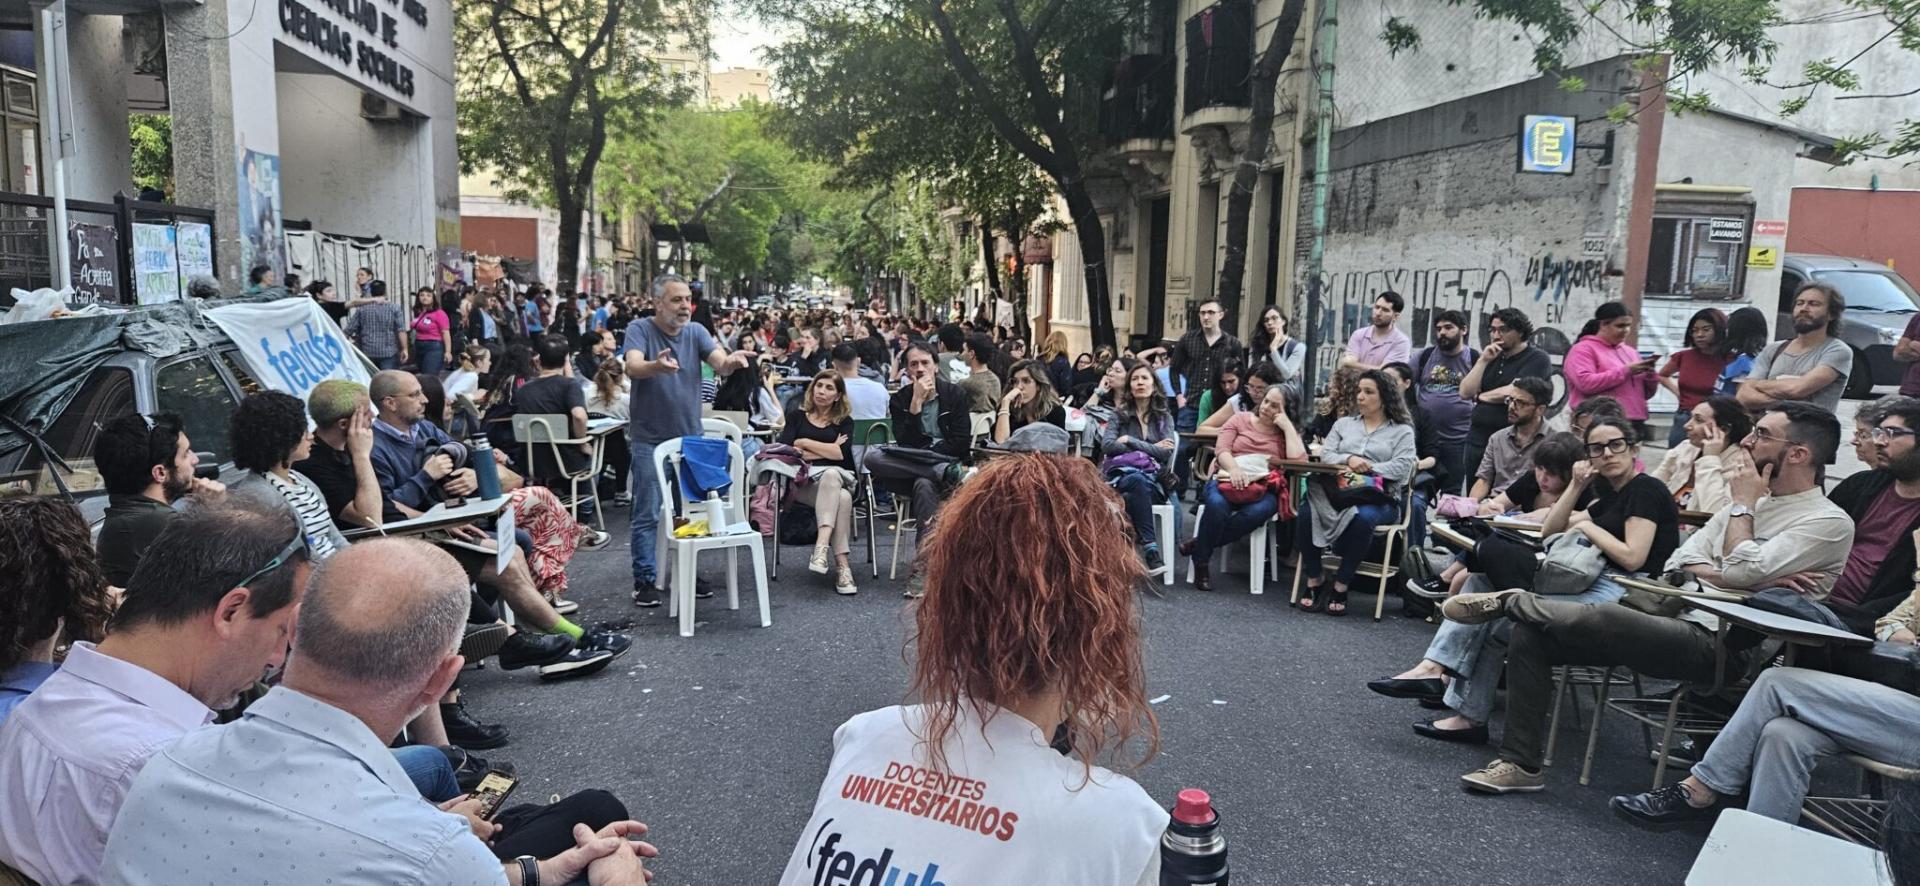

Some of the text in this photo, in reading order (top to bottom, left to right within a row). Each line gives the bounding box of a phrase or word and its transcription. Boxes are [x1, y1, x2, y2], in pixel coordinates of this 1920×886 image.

[382, 12, 398, 48] DE
[279, 0, 415, 99] CIENCIAS SOCIALES
[1533, 121, 1565, 167] E
[1711, 230, 1742, 238] LAVANDO
[1713, 221, 1742, 229] ESTAMOS
[1583, 240, 1605, 252] 1052
[1525, 257, 1539, 287] LA
[1411, 267, 1512, 349] VETO
[1546, 303, 1563, 323] EN
[884, 762, 986, 801] DOCENTES
[841, 774, 1018, 842] UNIVERSITARIOS
